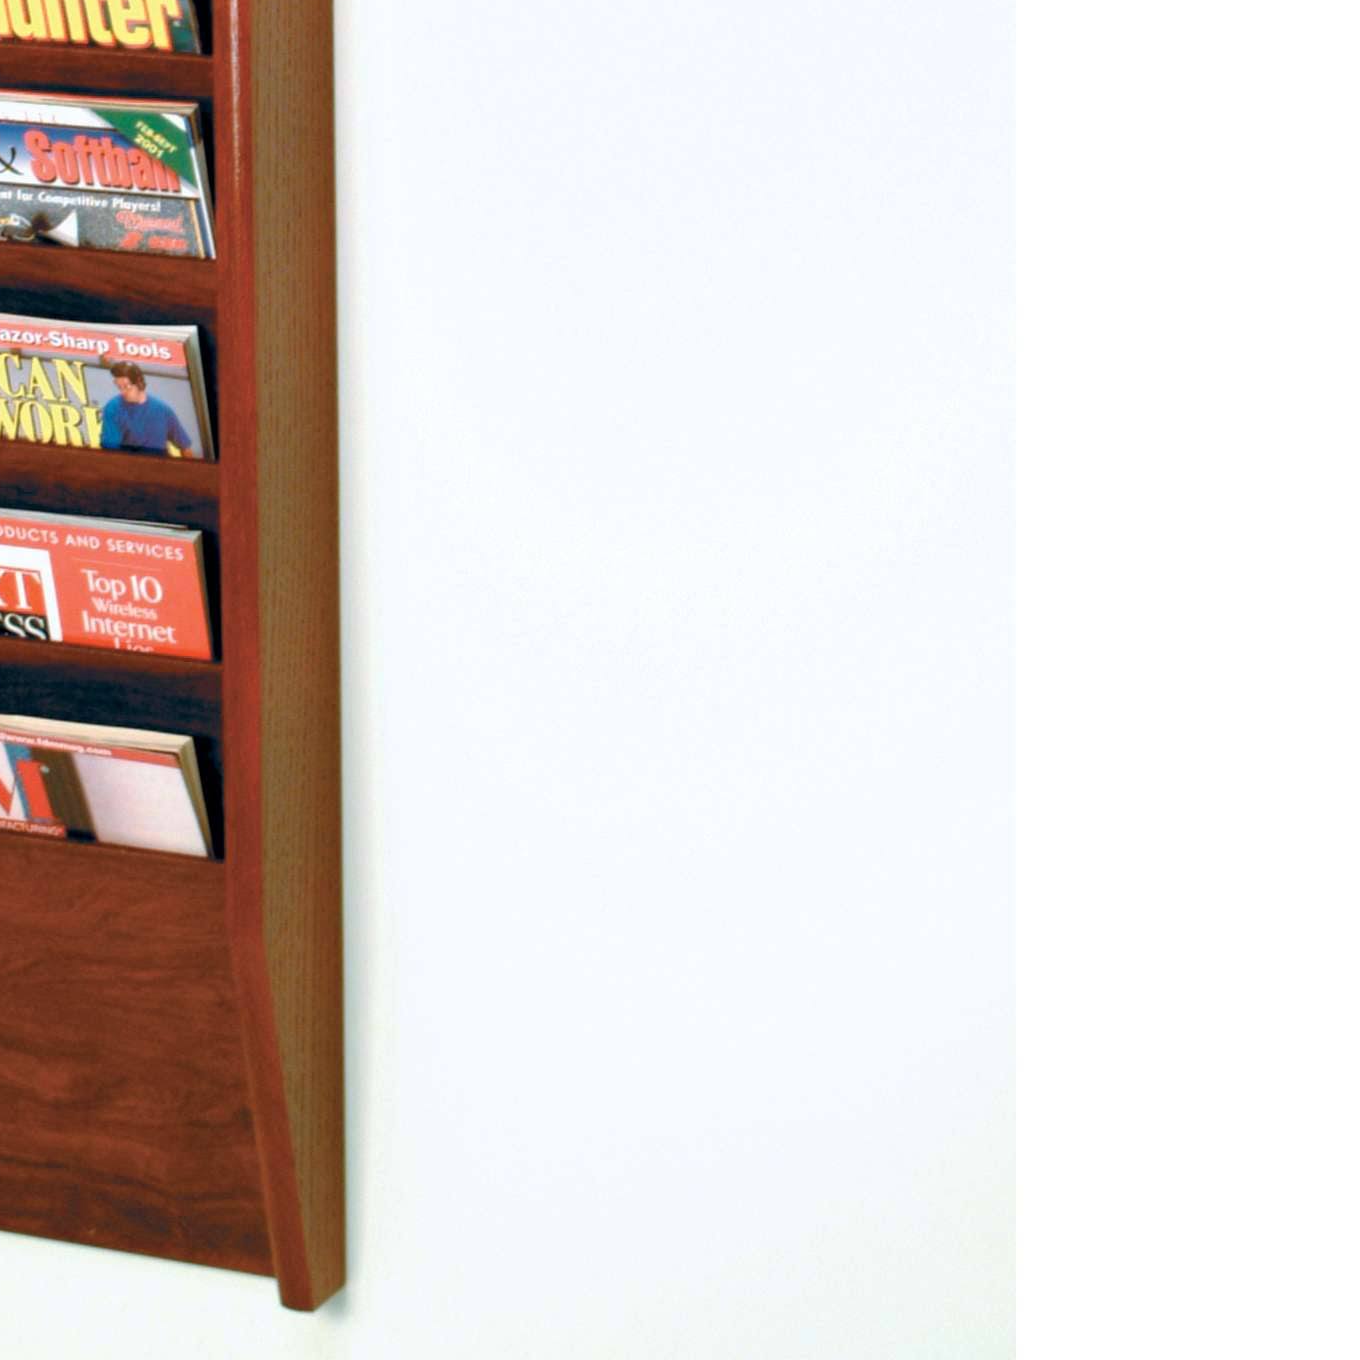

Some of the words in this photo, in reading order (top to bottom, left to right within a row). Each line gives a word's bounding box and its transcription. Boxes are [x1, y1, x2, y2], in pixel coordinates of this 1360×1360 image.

[133, 133, 165, 159] 2001
[17, 188, 34, 202] for
[38, 191, 108, 208] Competitive
[112, 197, 161, 214] Players!
[115, 337, 172, 360] Tools
[65, 534, 101, 550] AND
[107, 539, 185, 561] SERVICES
[80, 568, 127, 601] Top
[130, 575, 164, 604] 10
[91, 596, 158, 621] Wireless
[81, 609, 177, 645] Internet
